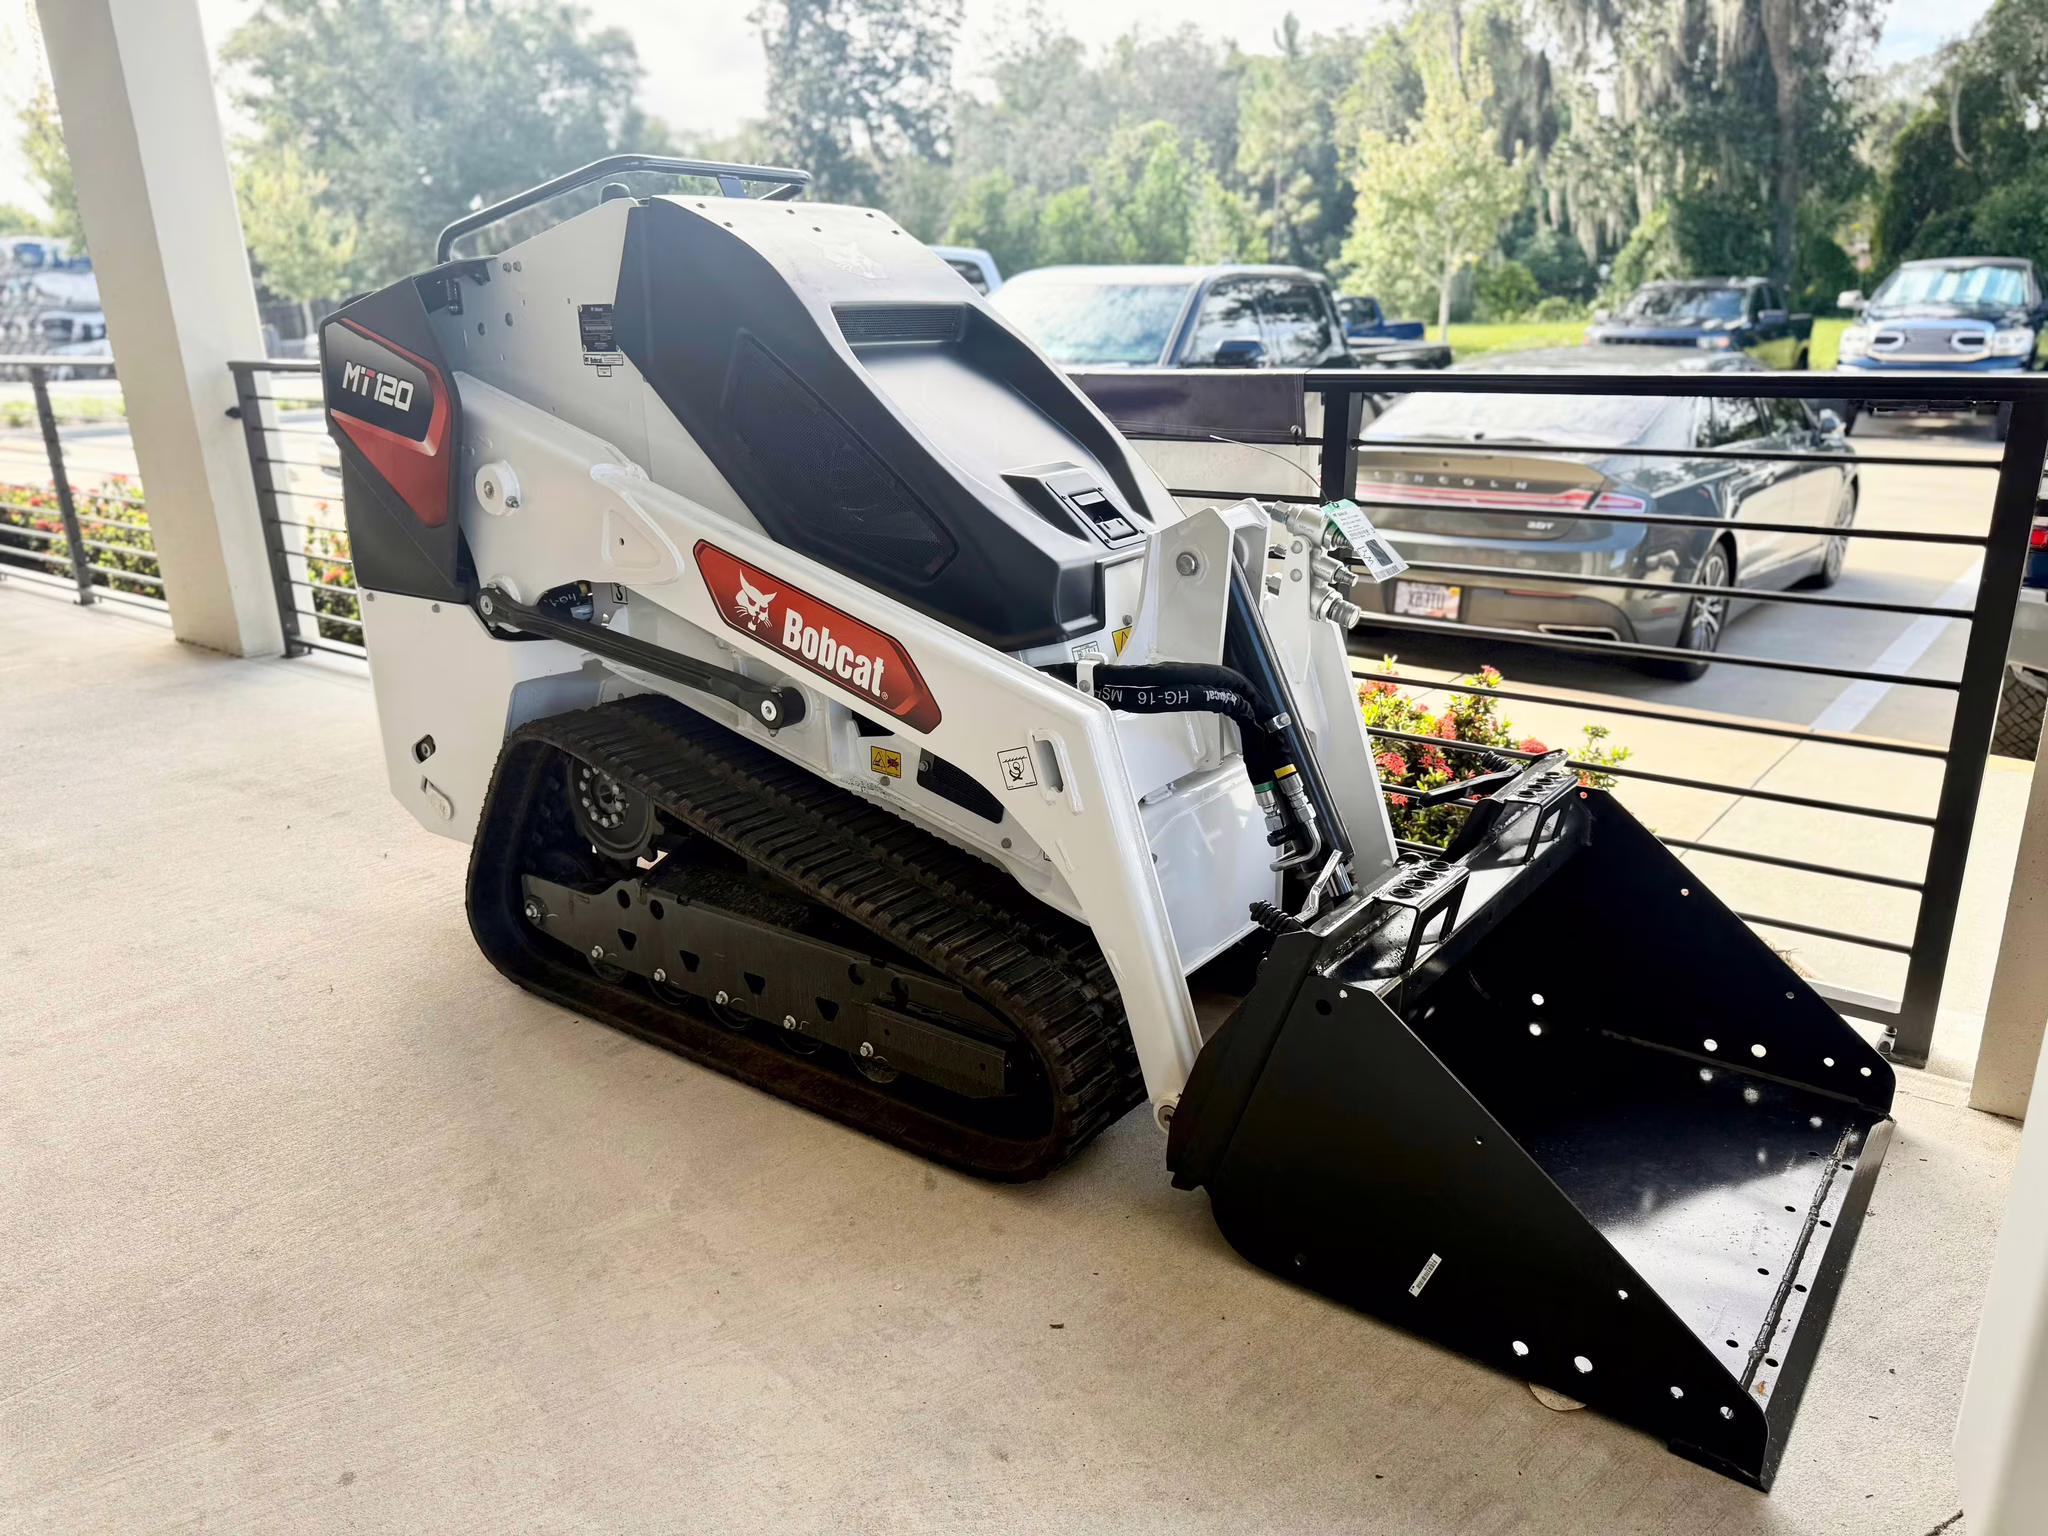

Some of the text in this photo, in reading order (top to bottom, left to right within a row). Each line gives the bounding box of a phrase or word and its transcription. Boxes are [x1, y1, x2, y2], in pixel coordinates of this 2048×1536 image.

[342, 361, 414, 412] MT120
[782, 607, 885, 697] Bobcat
[1138, 690, 1189, 705] HG-16
